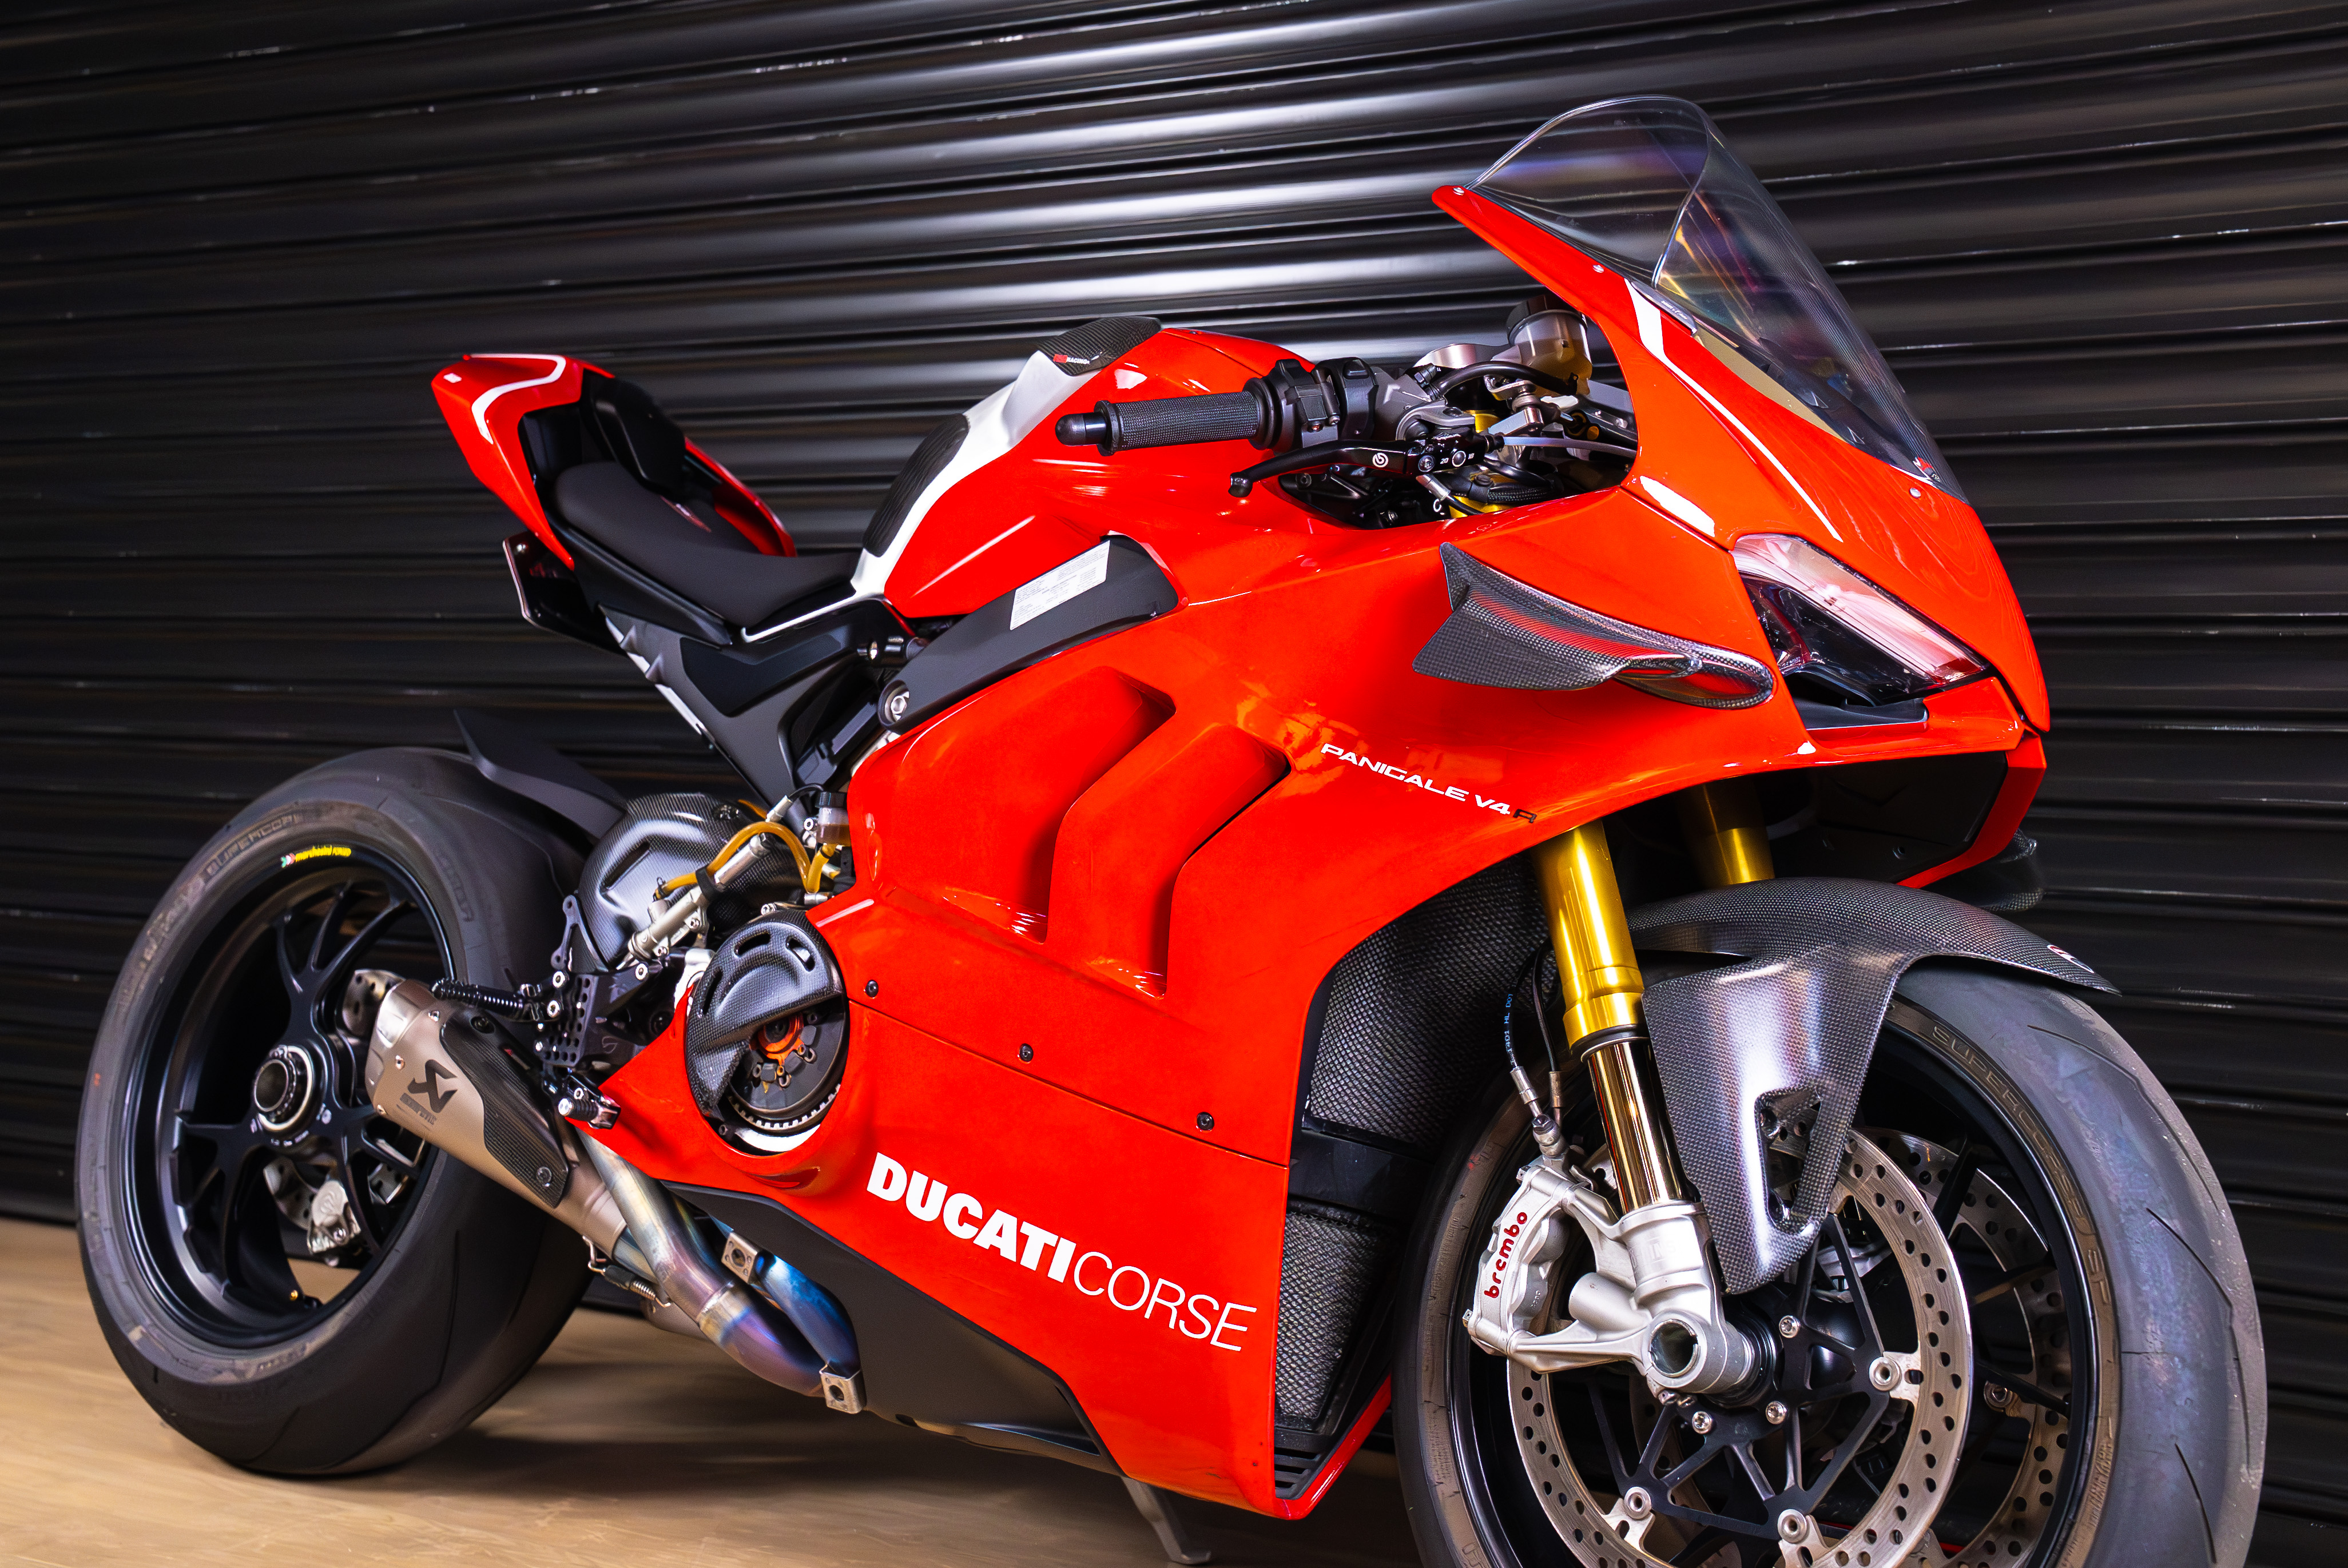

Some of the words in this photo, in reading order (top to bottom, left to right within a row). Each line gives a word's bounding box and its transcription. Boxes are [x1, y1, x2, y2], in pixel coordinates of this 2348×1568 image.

[1320, 743, 1469, 802] PANIGALE
[1504, 1012, 1510, 1024] HL
[1484, 1211, 1528, 1299] brembo
